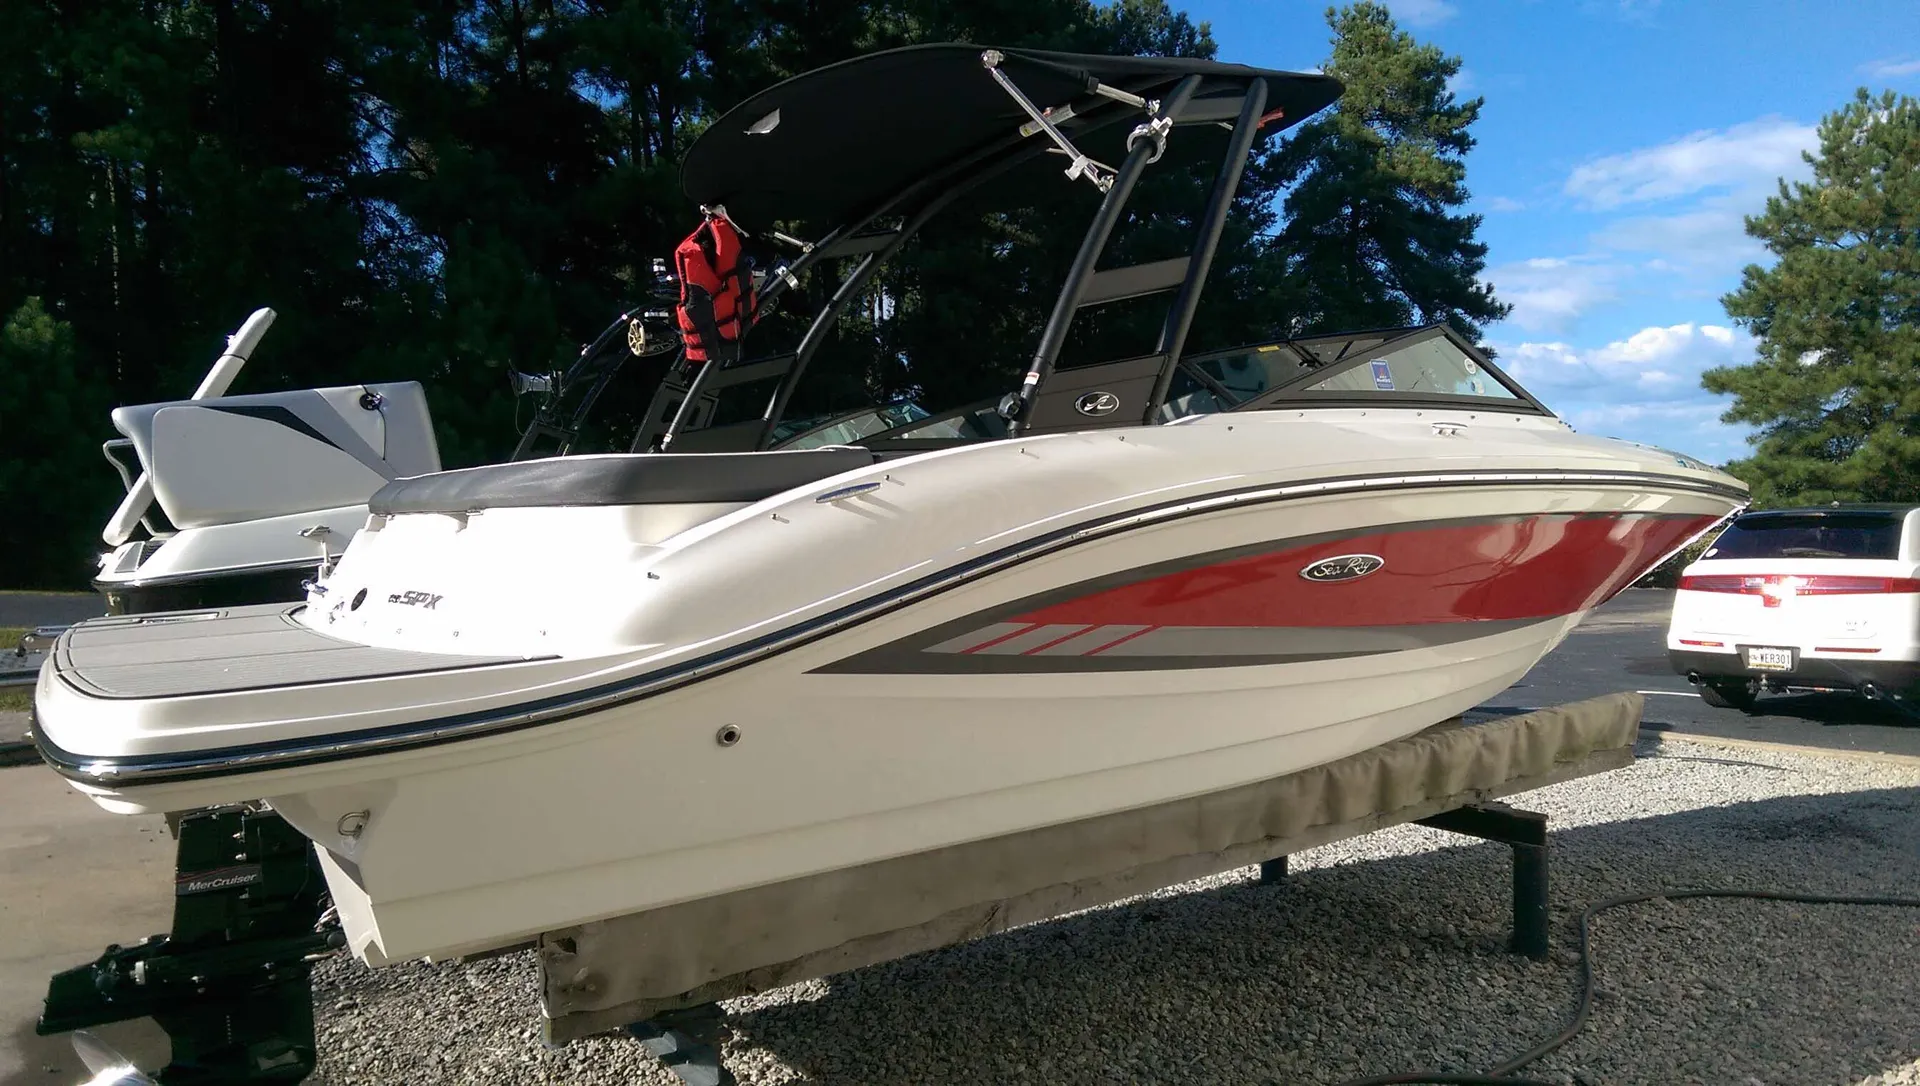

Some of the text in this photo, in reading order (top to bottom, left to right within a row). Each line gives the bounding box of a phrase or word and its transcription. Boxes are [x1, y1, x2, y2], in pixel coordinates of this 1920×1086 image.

[1313, 557, 1373, 577] Sea Ray
[400, 590, 444, 610] SPX
[1759, 653, 1790, 665] WER301
[188, 873, 257, 891] MerCruiser
